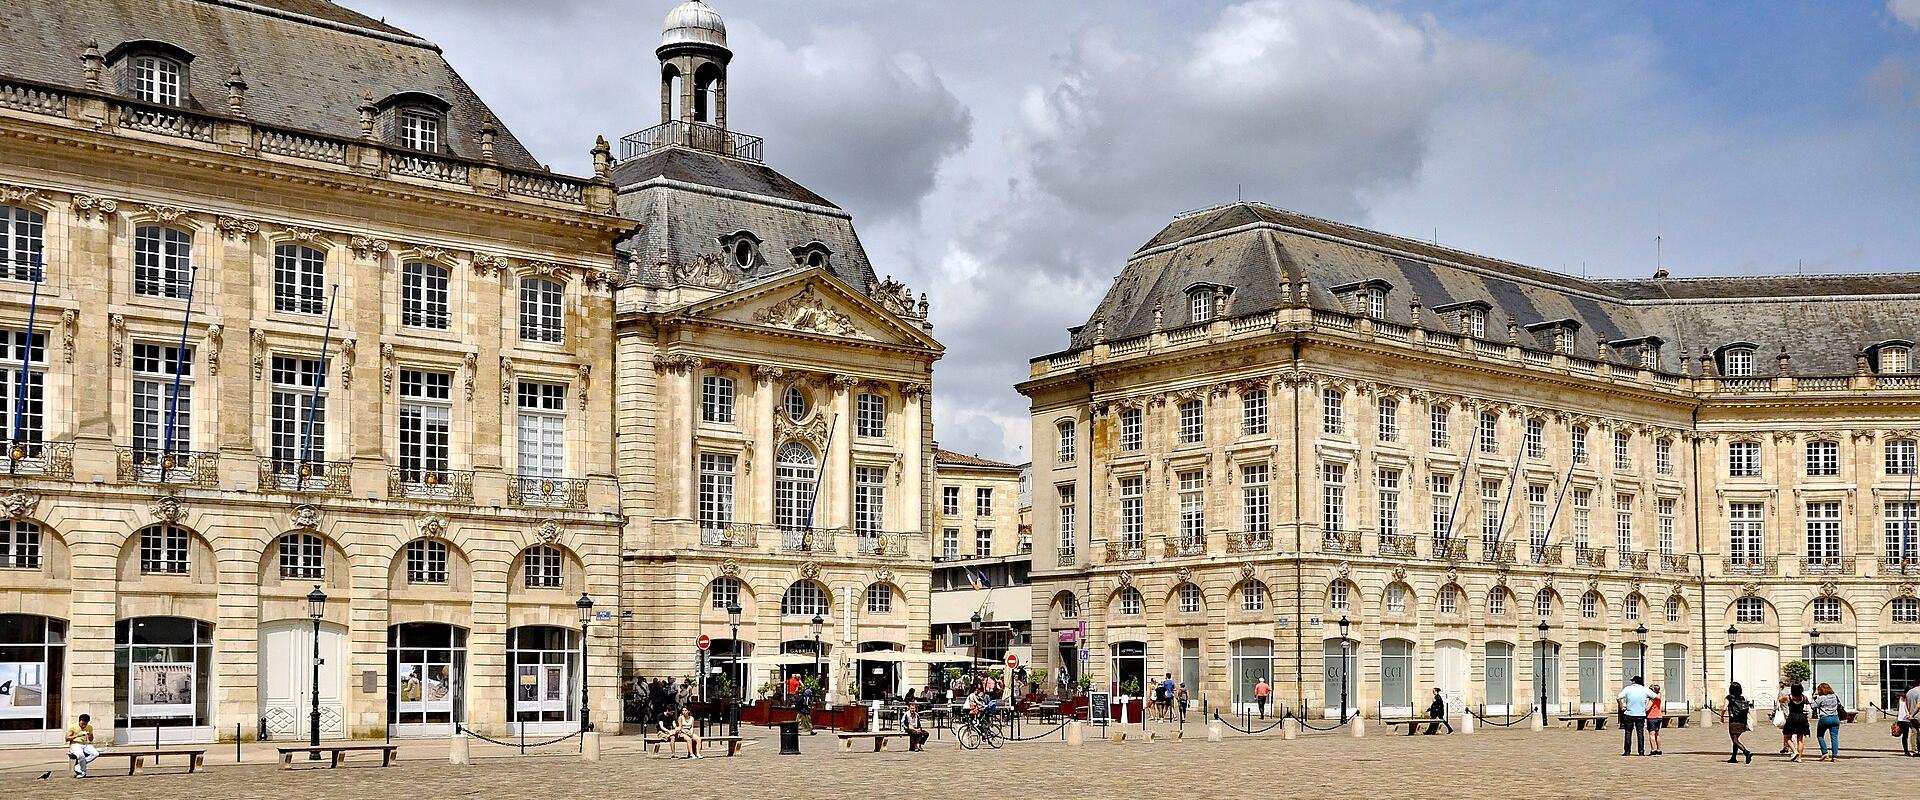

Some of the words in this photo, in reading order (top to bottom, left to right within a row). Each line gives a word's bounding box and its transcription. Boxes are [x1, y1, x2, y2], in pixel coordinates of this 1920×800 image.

[1817, 645, 1838, 655] CCI
[1384, 667, 1401, 678] CCI
[1488, 667, 1503, 678] CCI
